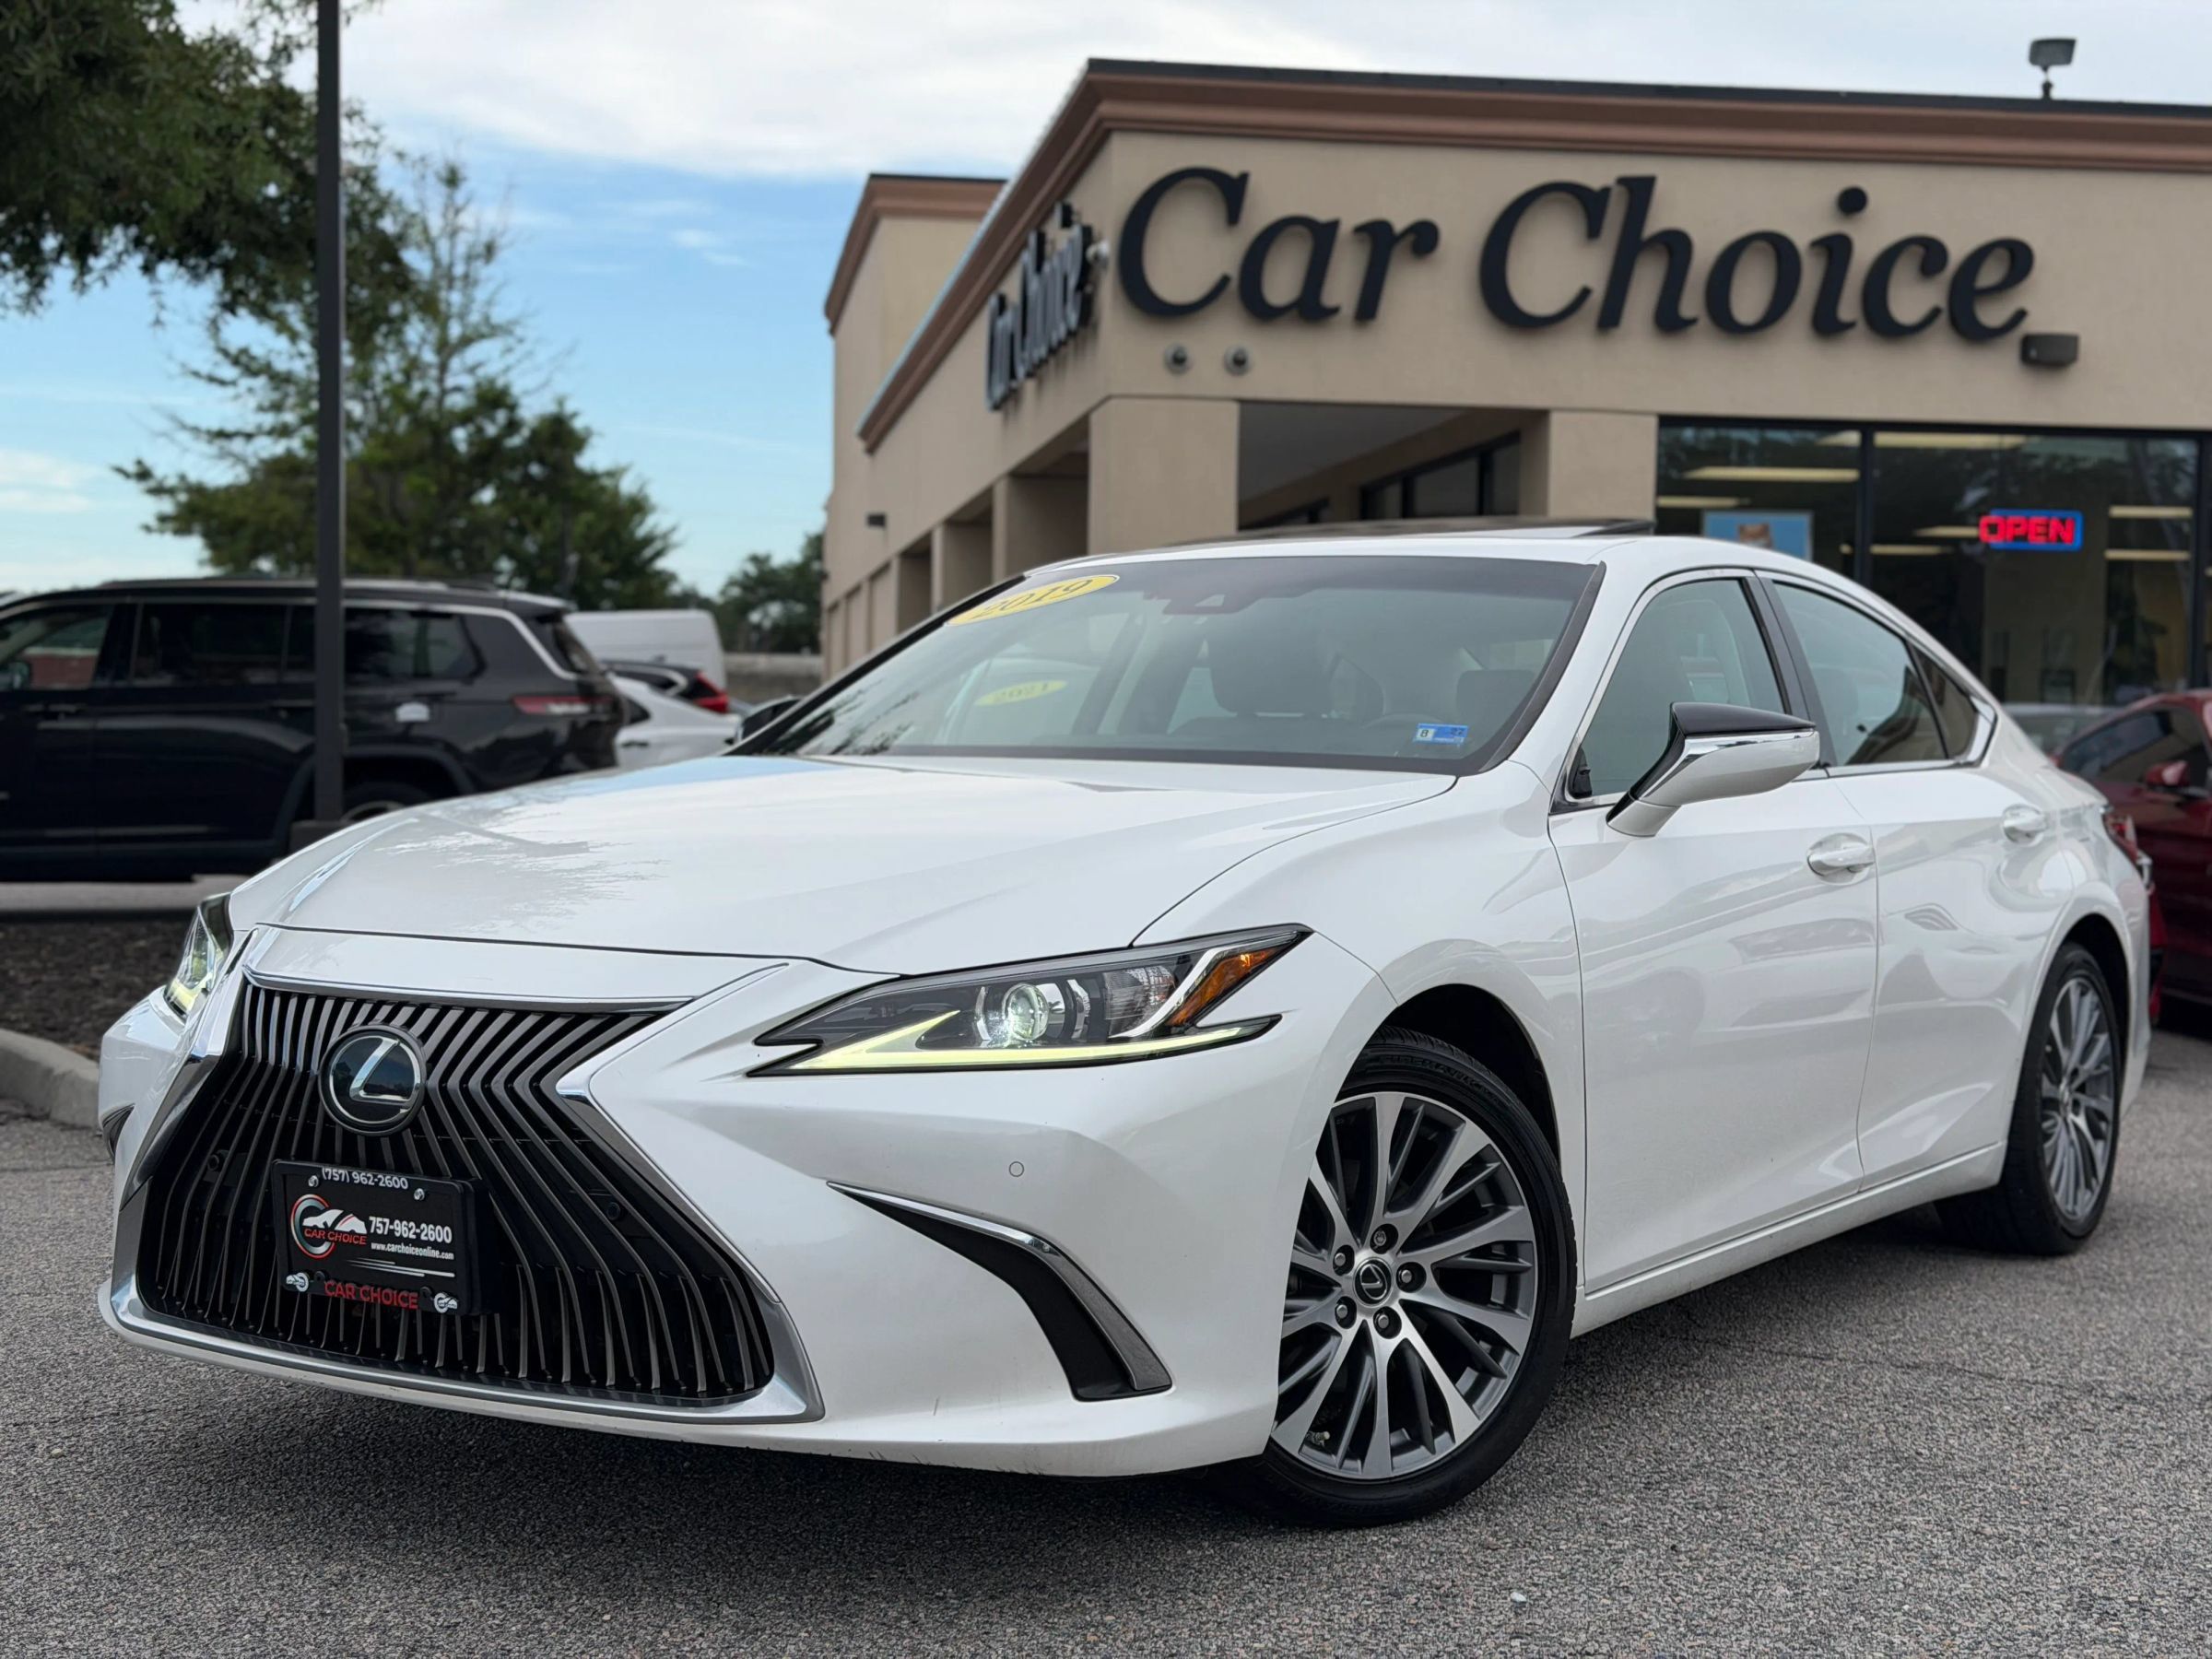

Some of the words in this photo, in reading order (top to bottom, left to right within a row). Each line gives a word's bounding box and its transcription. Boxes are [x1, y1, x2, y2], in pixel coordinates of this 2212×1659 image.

[1117, 166, 1440, 324] Car
[1479, 175, 2034, 342] Choice
[1979, 515, 2076, 545] OPEN
[969, 579, 1093, 619] 2019
[322, 1167, 350, 1183] (757)
[351, 1171, 408, 1190] 962-2600
[303, 1228, 326, 1240] CAR
[327, 1230, 367, 1245] CHOICE
[369, 1216, 453, 1244] 757-962-2600
[371, 1242, 454, 1260] www.carchoiceonline.com
[324, 1279, 356, 1300] CAR
[359, 1285, 418, 1310] CHOICE
